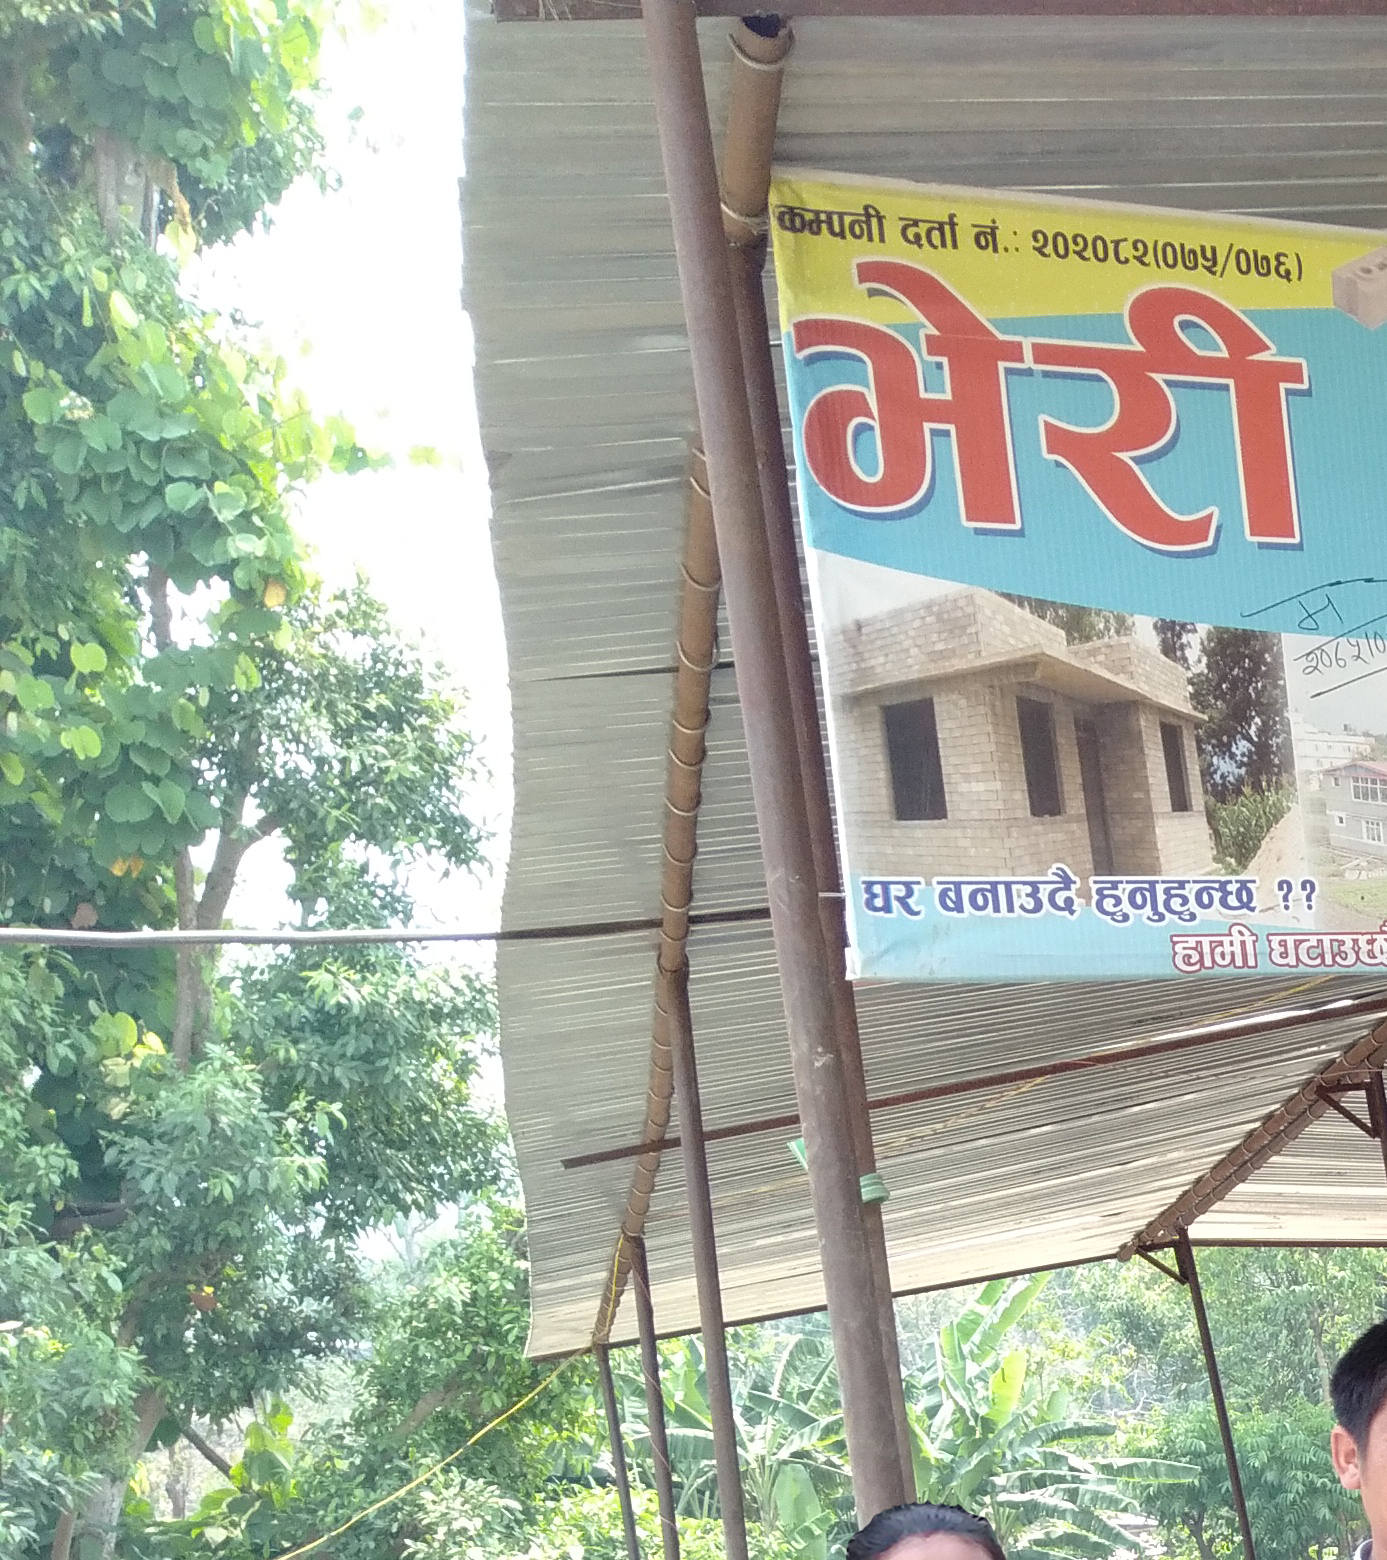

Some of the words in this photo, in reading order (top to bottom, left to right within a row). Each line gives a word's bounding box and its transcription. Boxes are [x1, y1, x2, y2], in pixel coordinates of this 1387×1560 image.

[776, 204, 886, 243] कम्पनी
[898, 213, 958, 250] दर्ता
[790, 258, 1310, 553] भेरी
[862, 878, 922, 917] घर
[1093, 878, 1257, 922] हुनुहुन्छ
[1170, 922, 1258, 970] हामी
